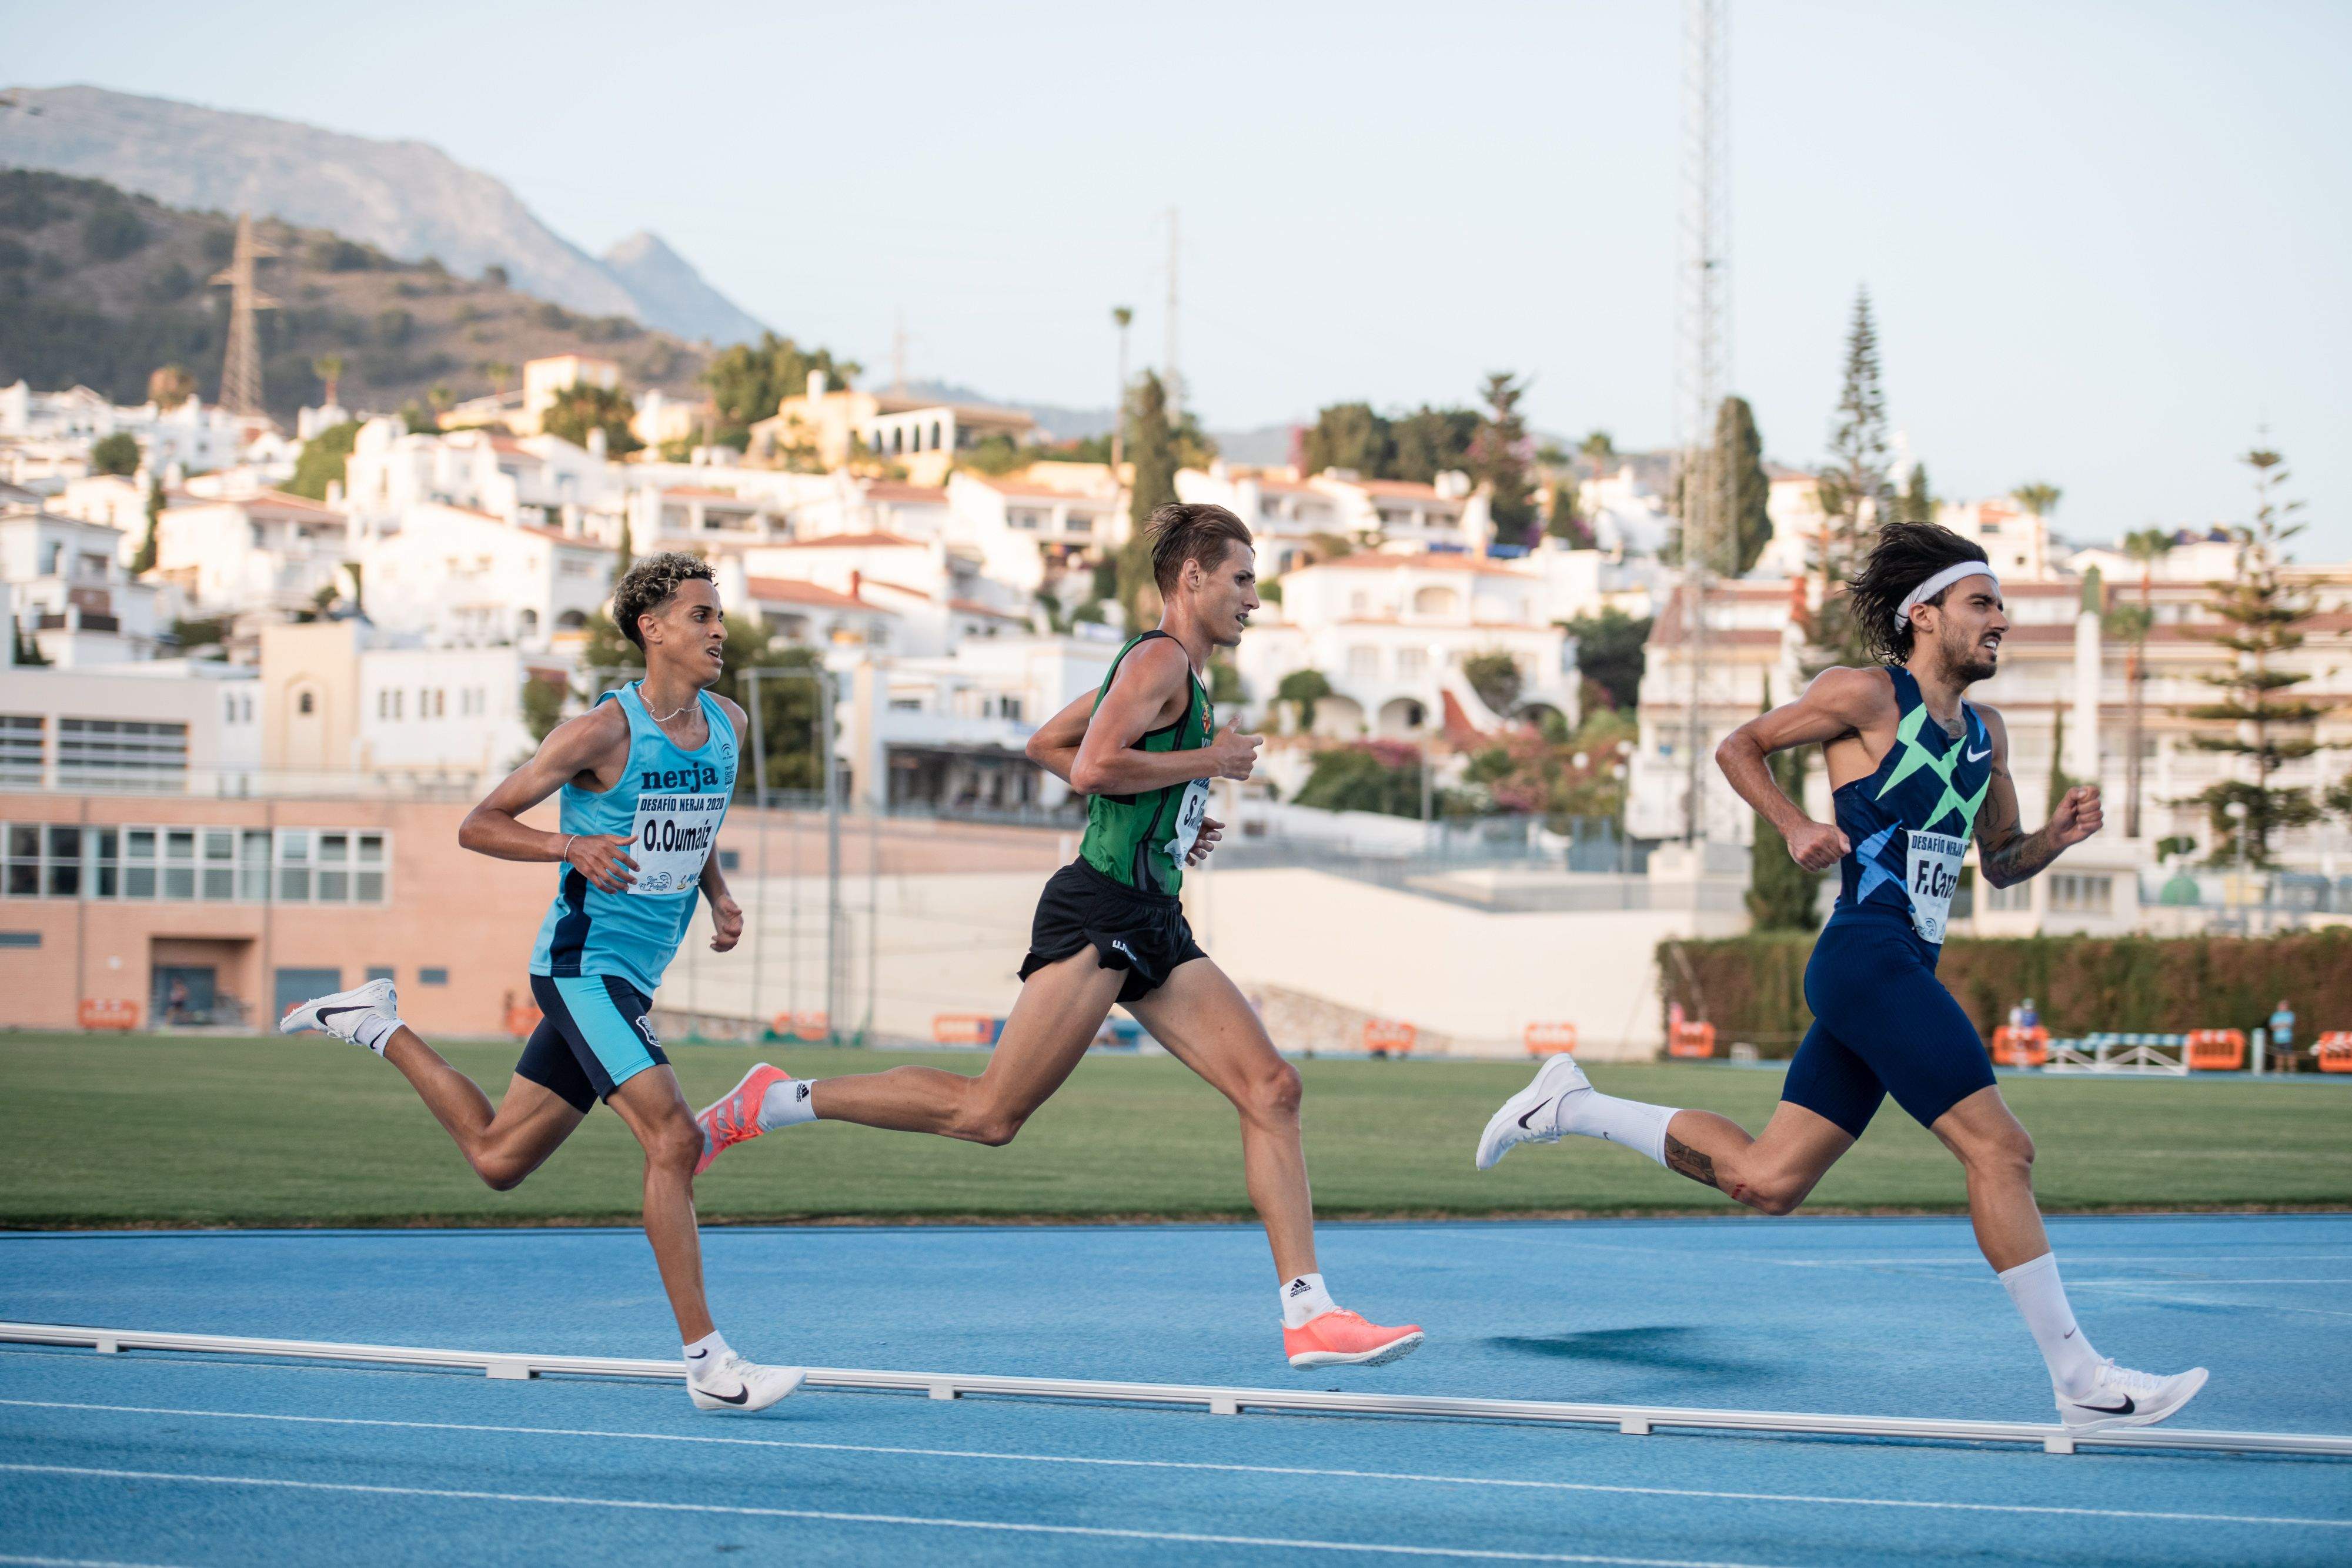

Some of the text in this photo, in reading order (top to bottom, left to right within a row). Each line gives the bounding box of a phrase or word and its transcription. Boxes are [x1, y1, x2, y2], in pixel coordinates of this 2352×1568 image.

[641, 762, 719, 793] nerja
[640, 796, 725, 811] DESAFÍO NERJA 2020
[1911, 835, 1945, 854] DESAFÍO
[1946, 840, 1963, 858] NERJA
[1290, 1285, 1311, 1298] adidas
